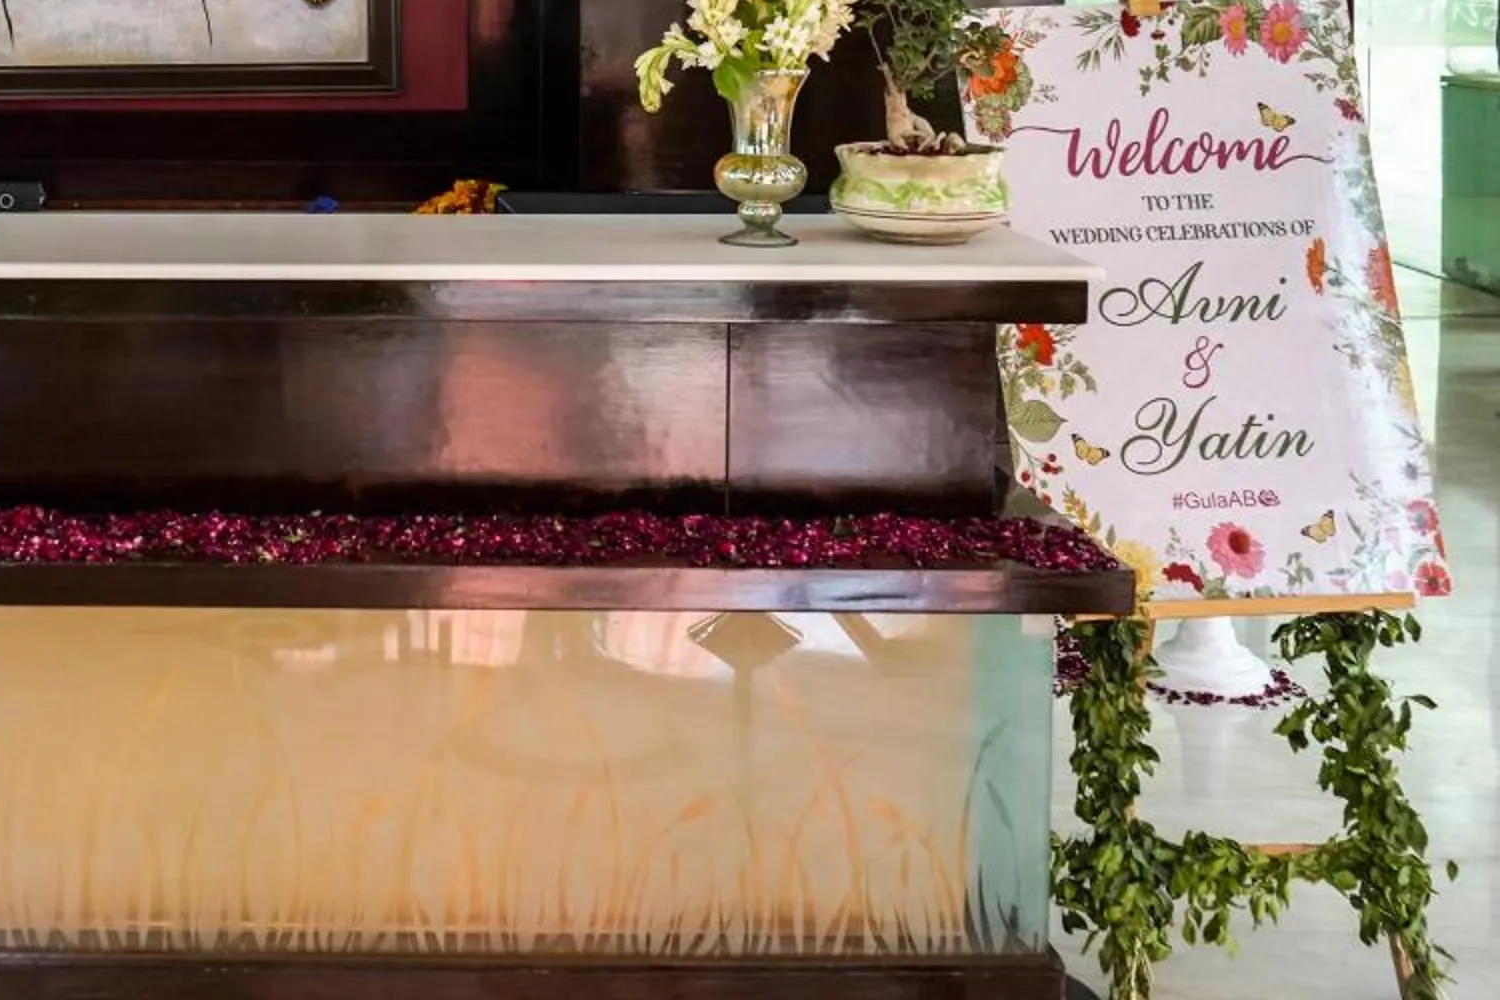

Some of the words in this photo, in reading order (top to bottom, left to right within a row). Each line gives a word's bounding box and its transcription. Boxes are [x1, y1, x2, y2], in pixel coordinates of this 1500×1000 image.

[1011, 107, 1334, 179] Welcome
[1141, 194, 1169, 211] TO
[1171, 193, 1214, 210] THE
[1050, 225, 1142, 245] WEDDING
[1145, 220, 1286, 242] CELEBRATIONS
[1290, 219, 1315, 237] OF
[1099, 261, 1287, 326] Avni
[1183, 336, 1224, 388] &
[1121, 395, 1314, 475] Yatin
